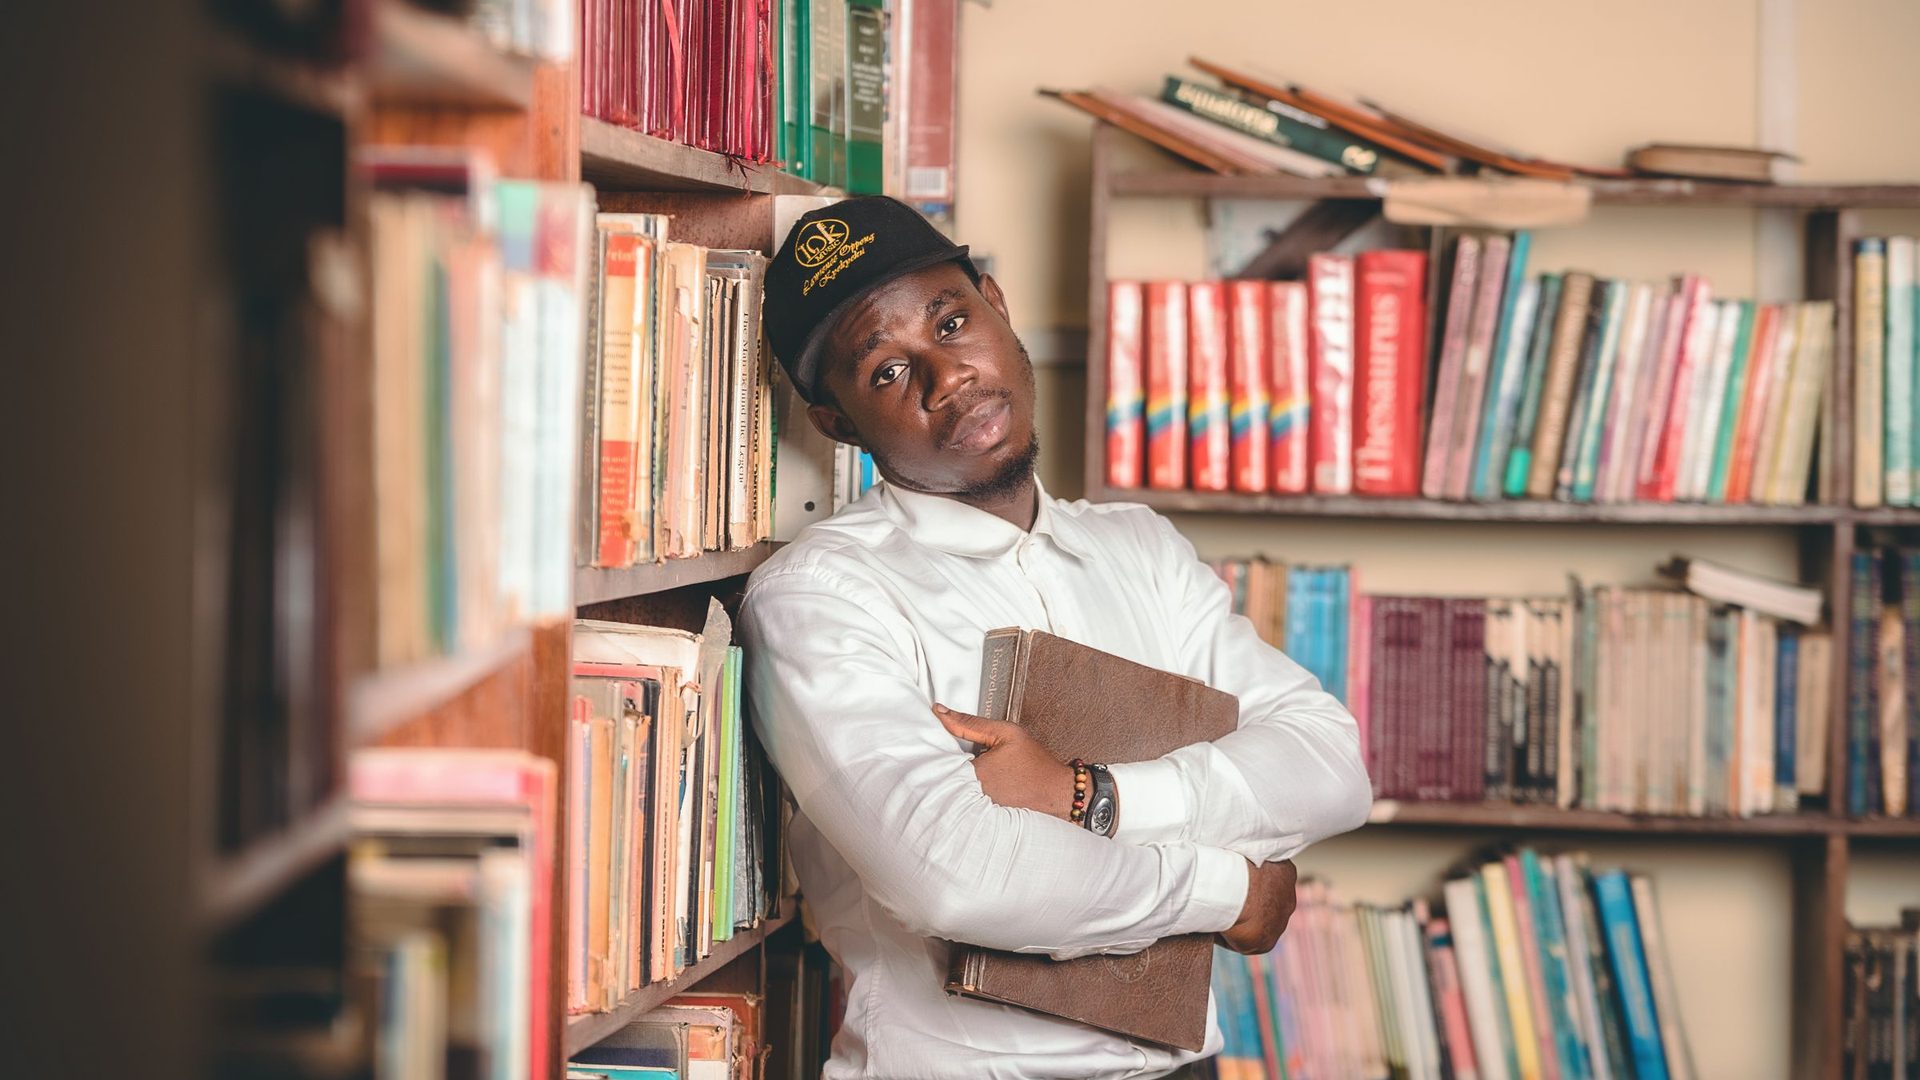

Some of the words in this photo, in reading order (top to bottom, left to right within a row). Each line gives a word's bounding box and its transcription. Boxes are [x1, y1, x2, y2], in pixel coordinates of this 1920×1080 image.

[815, 239, 841, 262] MUSIC
[839, 232, 876, 257] Oppong
[1355, 292, 1399, 490] Thesaurus
